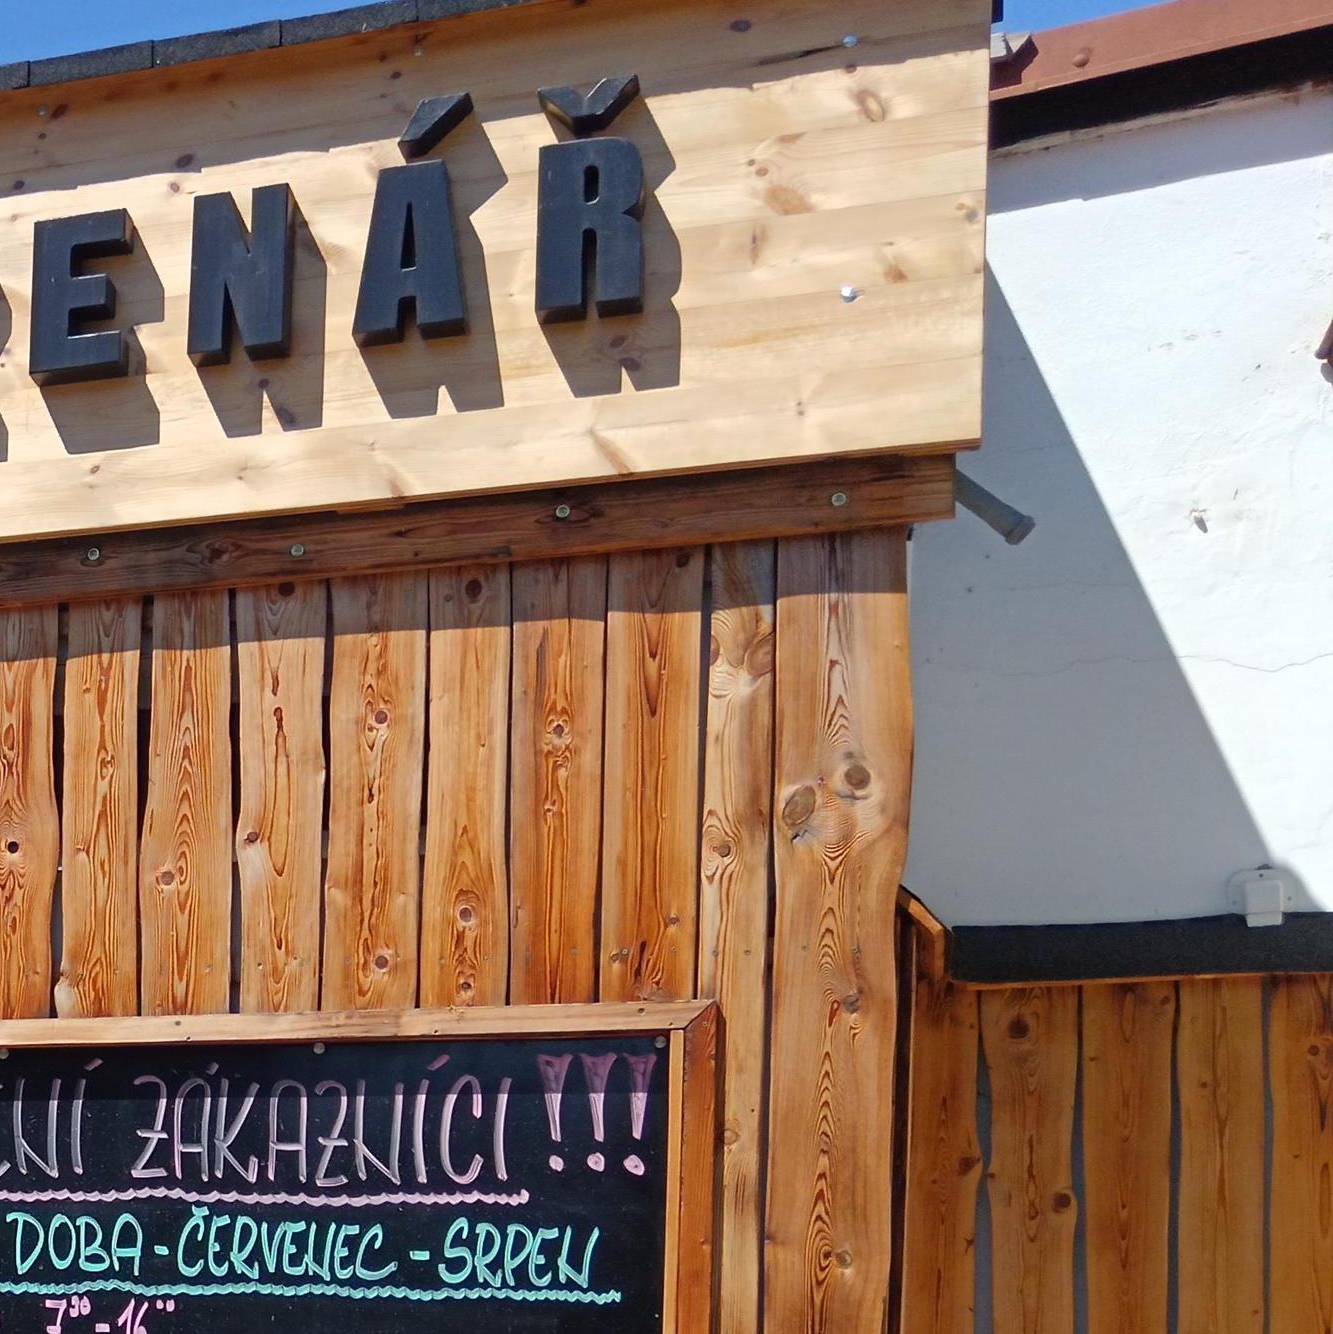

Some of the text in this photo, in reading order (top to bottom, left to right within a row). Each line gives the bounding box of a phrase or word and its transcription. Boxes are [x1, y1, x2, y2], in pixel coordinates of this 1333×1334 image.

[130, 1053, 513, 1188] ZÁKAZNÍCI
[5, 1211, 143, 1276] DOBA
[177, 1204, 398, 1282] ČERVENEC
[437, 1216, 601, 1289] SRPEN
